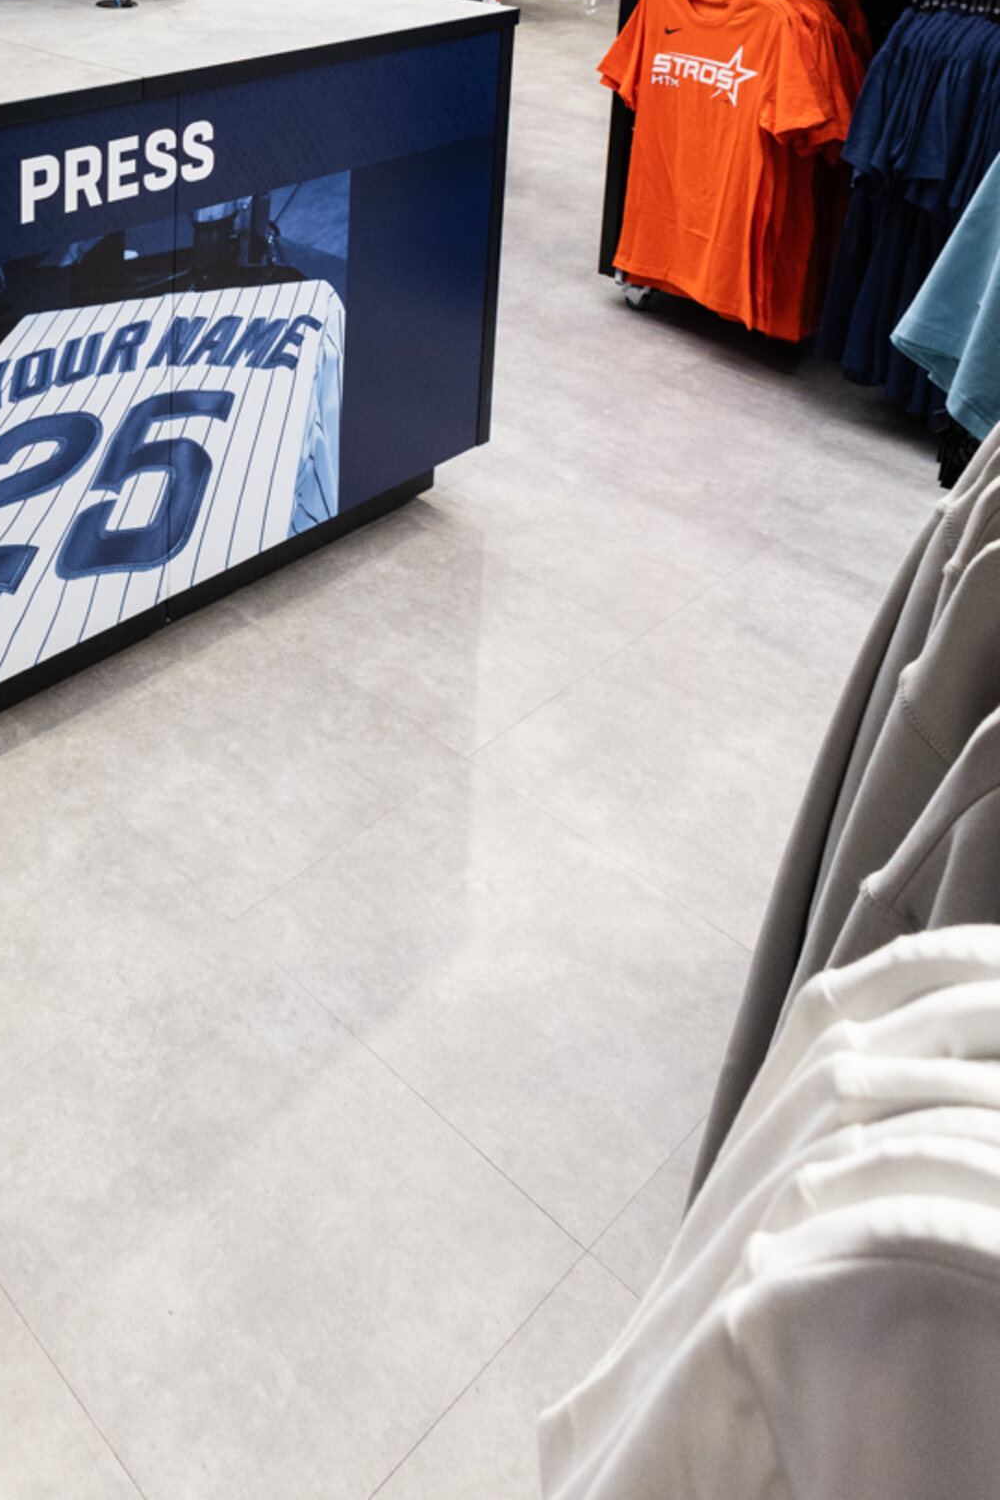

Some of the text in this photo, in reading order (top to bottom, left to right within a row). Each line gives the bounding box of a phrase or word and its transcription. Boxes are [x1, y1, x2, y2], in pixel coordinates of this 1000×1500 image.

[651, 53, 735, 90] STROS
[651, 74, 679, 88] HTX
[20, 120, 216, 225] PRESS
[144, 314, 324, 373] NAME
